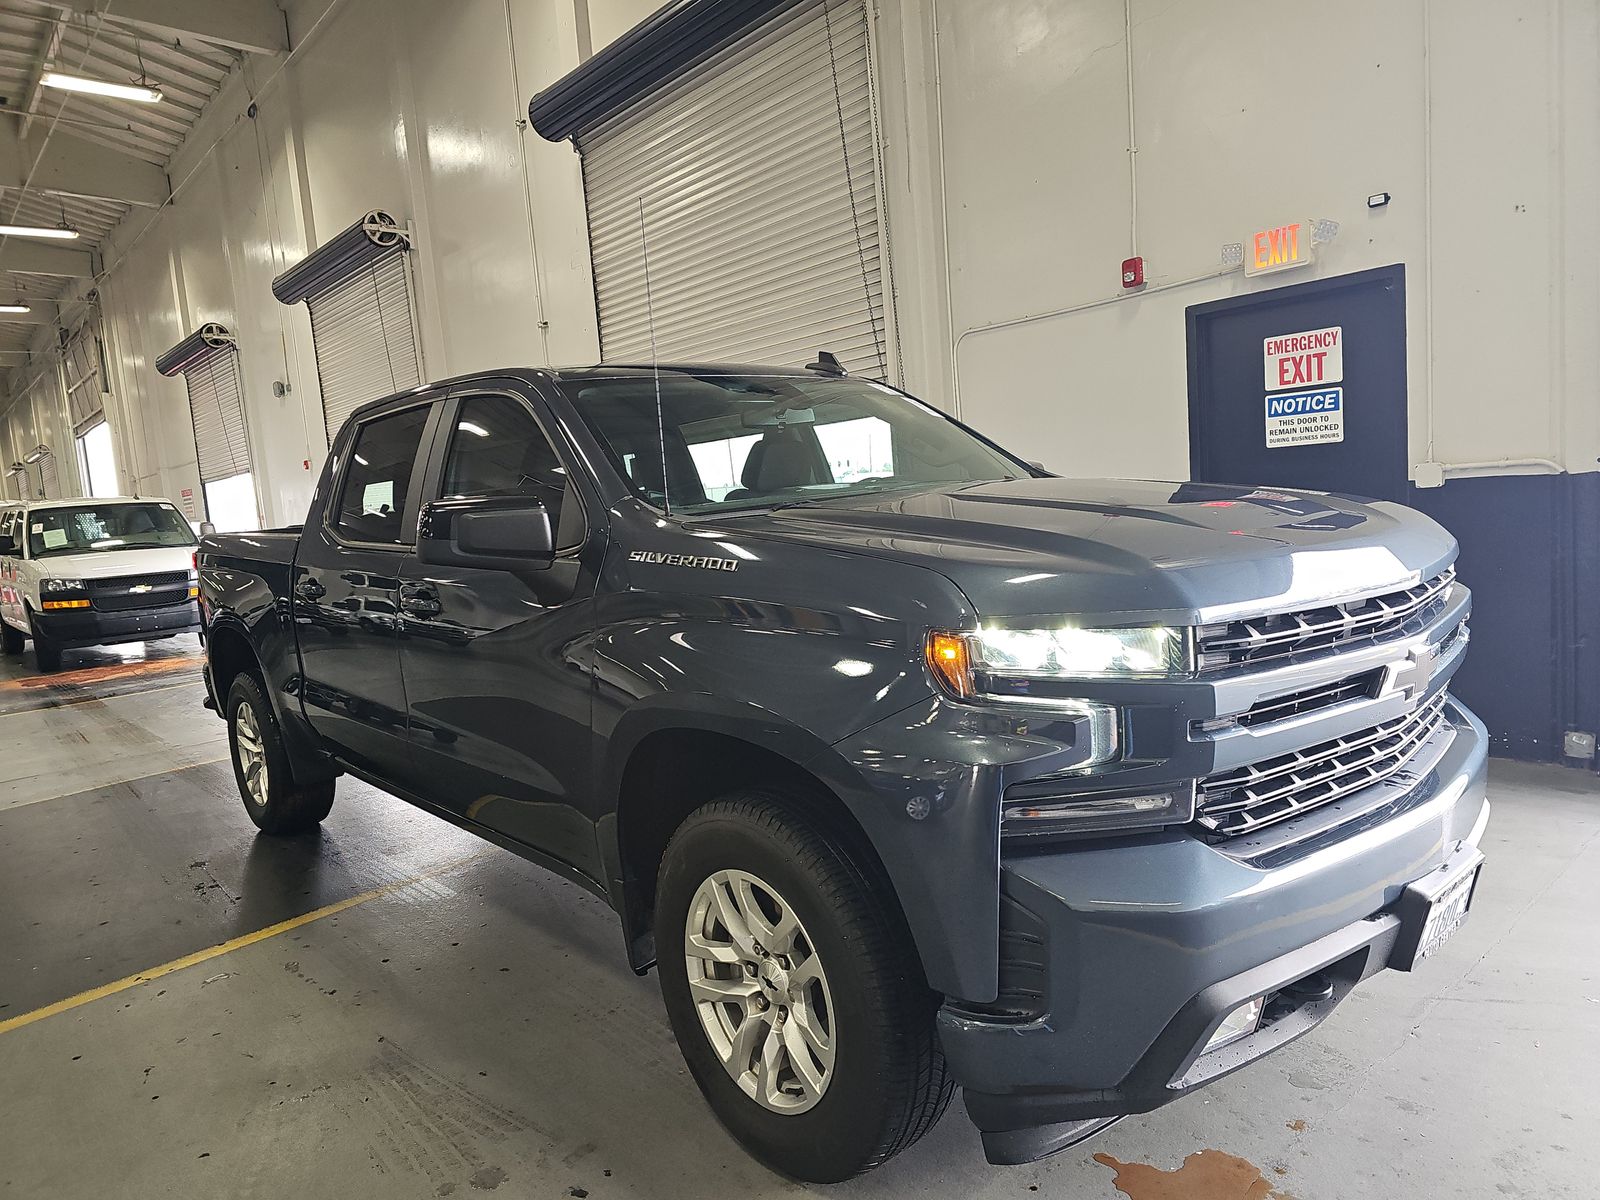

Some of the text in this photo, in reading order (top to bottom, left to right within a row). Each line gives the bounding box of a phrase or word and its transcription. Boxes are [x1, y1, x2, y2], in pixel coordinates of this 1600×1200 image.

[1254, 223, 1301, 270] EXIT
[1267, 330, 1339, 356] EMERGENCY
[1278, 352, 1328, 386] EXIT
[1270, 393, 1337, 415] NOTICE
[1269, 423, 1340, 436] REMAIN UNLOCKED
[1279, 415, 1329, 427] THIS DOOR TO
[1269, 432, 1340, 444] DURING BUSINESS HOURS
[628, 550, 739, 572] SILVERADO
